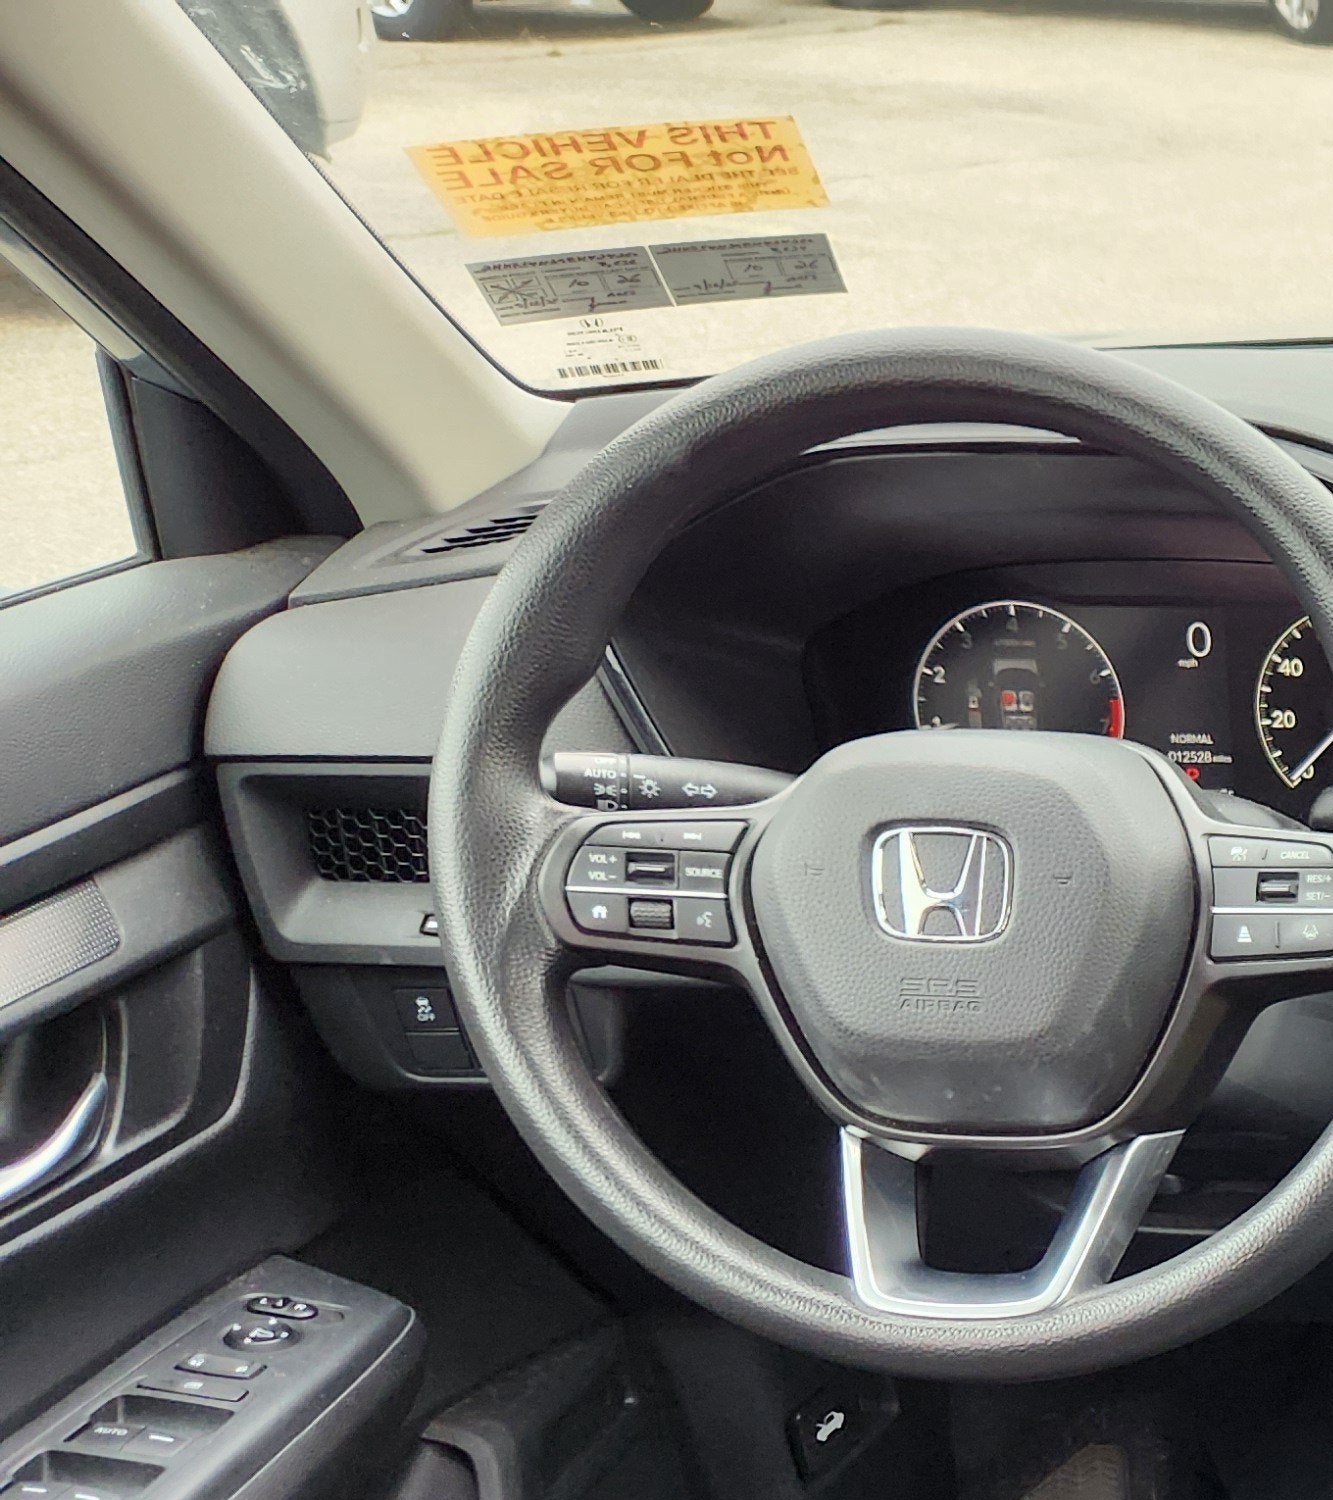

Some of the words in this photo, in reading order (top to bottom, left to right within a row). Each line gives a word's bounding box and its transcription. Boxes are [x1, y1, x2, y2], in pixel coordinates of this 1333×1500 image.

[1186, 621, 1211, 658] 0
[1277, 657, 1304, 677] 40
[933, 665, 946, 684] 2
[1270, 709, 1296, 729] 20
[1170, 733, 1214, 745] NORMAL
[584, 767, 617, 779] AUTO
[588, 853, 607, 864] VOL
[1280, 850, 1310, 860] CANCEL
[588, 869, 607, 881] VOL
